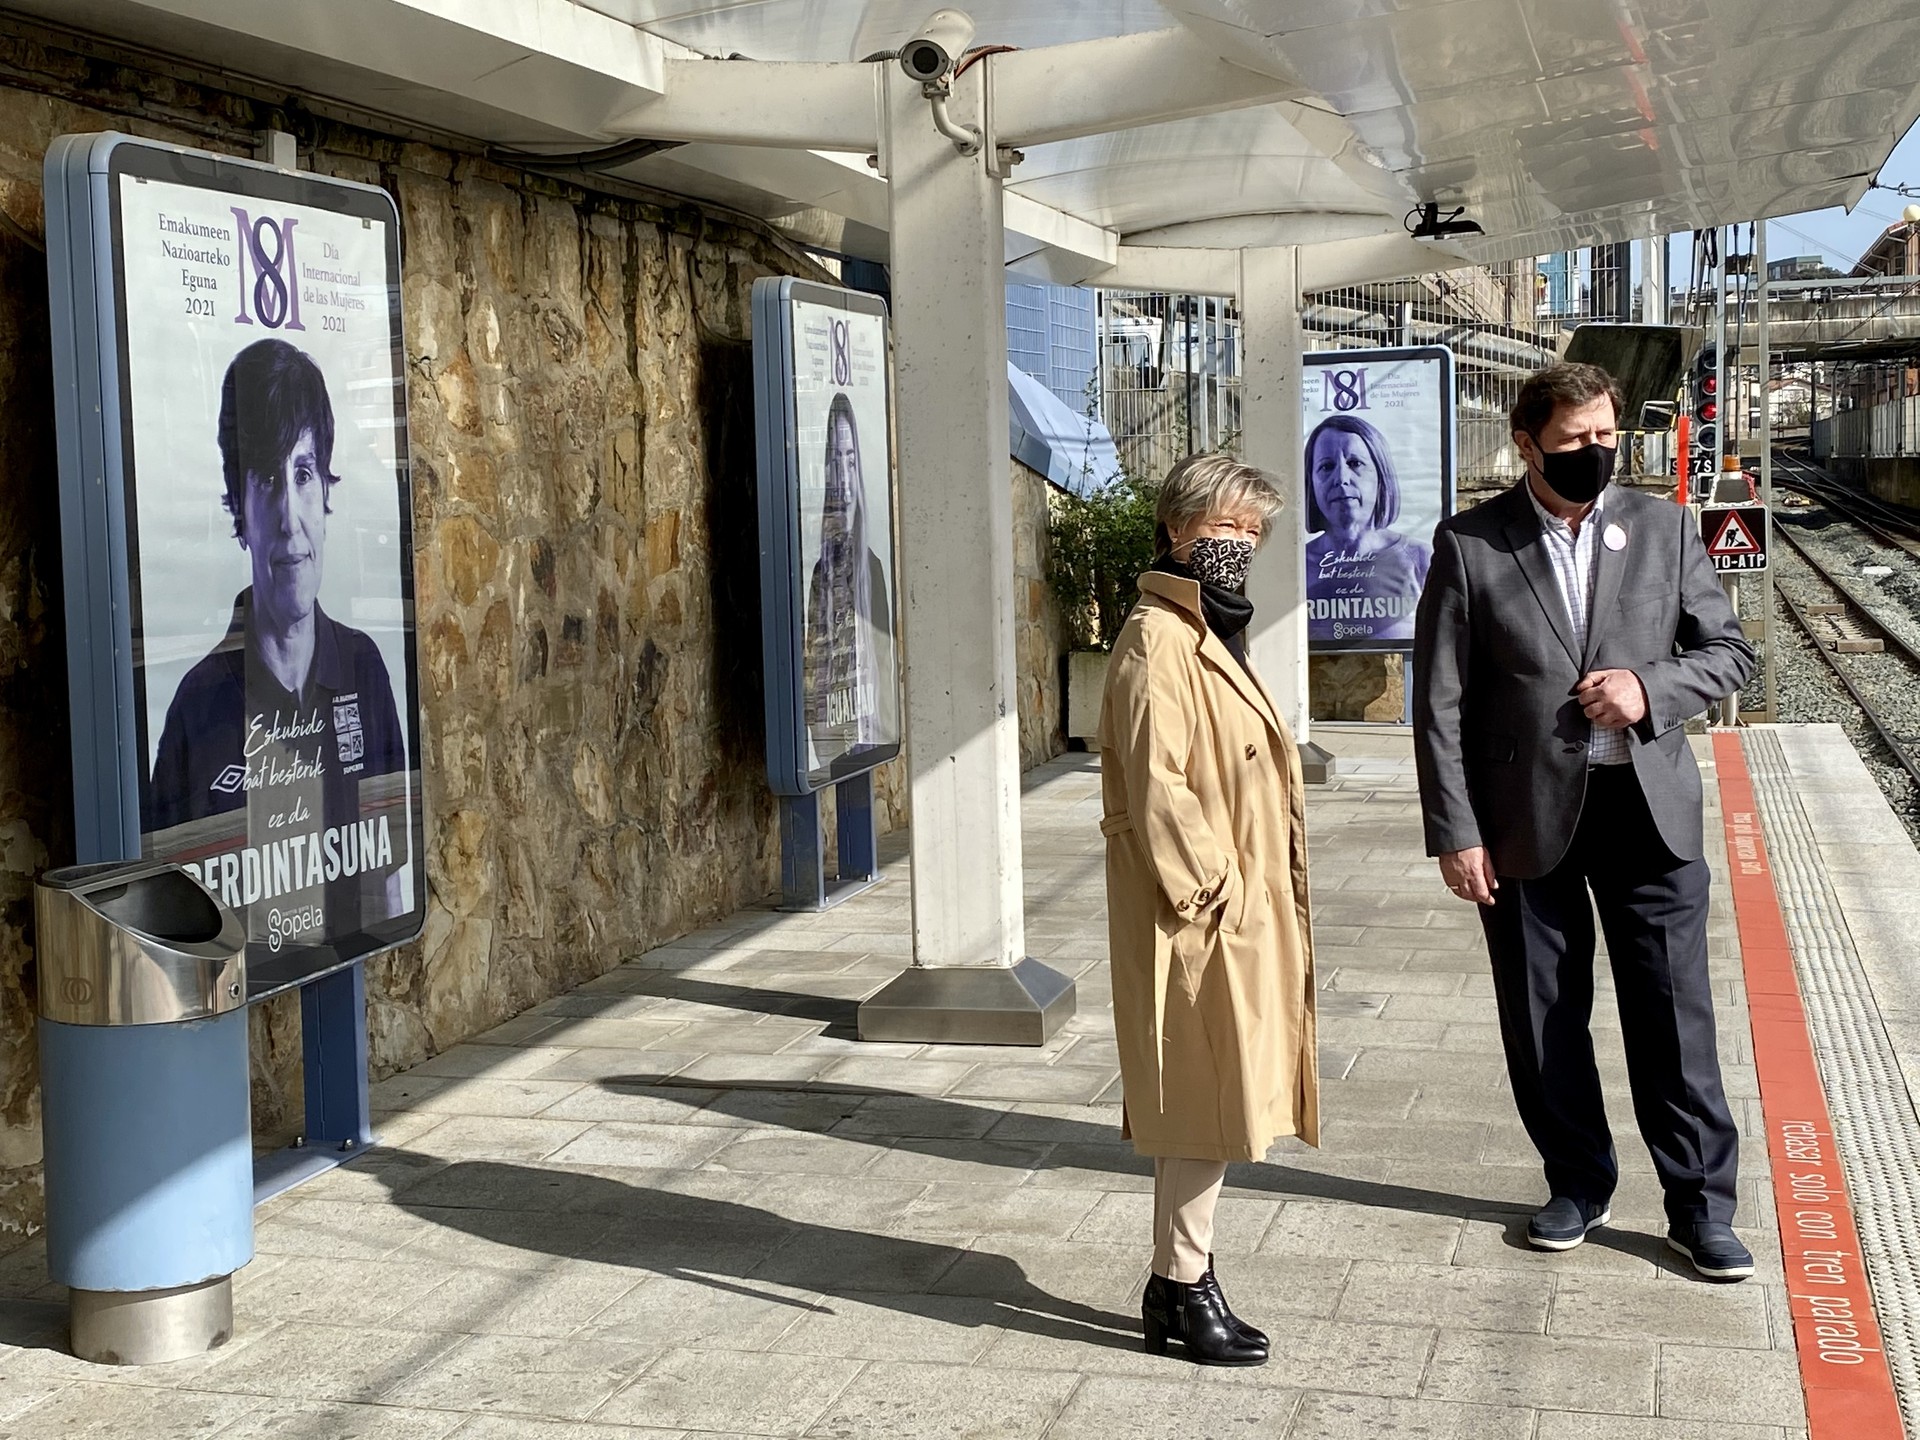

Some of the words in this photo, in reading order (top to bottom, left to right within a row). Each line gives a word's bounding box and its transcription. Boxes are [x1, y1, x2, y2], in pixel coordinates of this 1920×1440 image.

[158, 213, 231, 242] Emakumeen
[162, 239, 231, 267] Nazioarteko
[182, 269, 218, 293] Eguna
[302, 263, 361, 287] Internacional
[185, 298, 216, 317] 2021
[303, 286, 315, 303] de
[315, 288, 329, 306] las
[330, 290, 365, 312] Mujeres
[322, 316, 346, 333] 2021
[1370, 381, 1418, 390] Internacional
[1370, 391, 1379, 399] de
[1391, 390, 1420, 400] Mujeres
[1319, 550, 1377, 568] Eskubide
[1319, 567, 1337, 579] bat
[1337, 565, 1378, 579] besterik
[1335, 586, 1349, 595] ez
[1349, 583, 1366, 595] da
[1333, 622, 1374, 639] Sopela
[243, 707, 326, 758] Eskubide
[242, 755, 267, 791] bat
[269, 745, 326, 787] besterik
[268, 809, 286, 829] ez
[288, 796, 311, 824] da
[268, 905, 324, 952] Sopela
[1781, 1120, 1831, 1166] rebasar
[1789, 1172, 1843, 1203] solo
[1795, 1210, 1838, 1240] con
[1803, 1250, 1853, 1285] tren
[1792, 1293, 1881, 1365] parado
